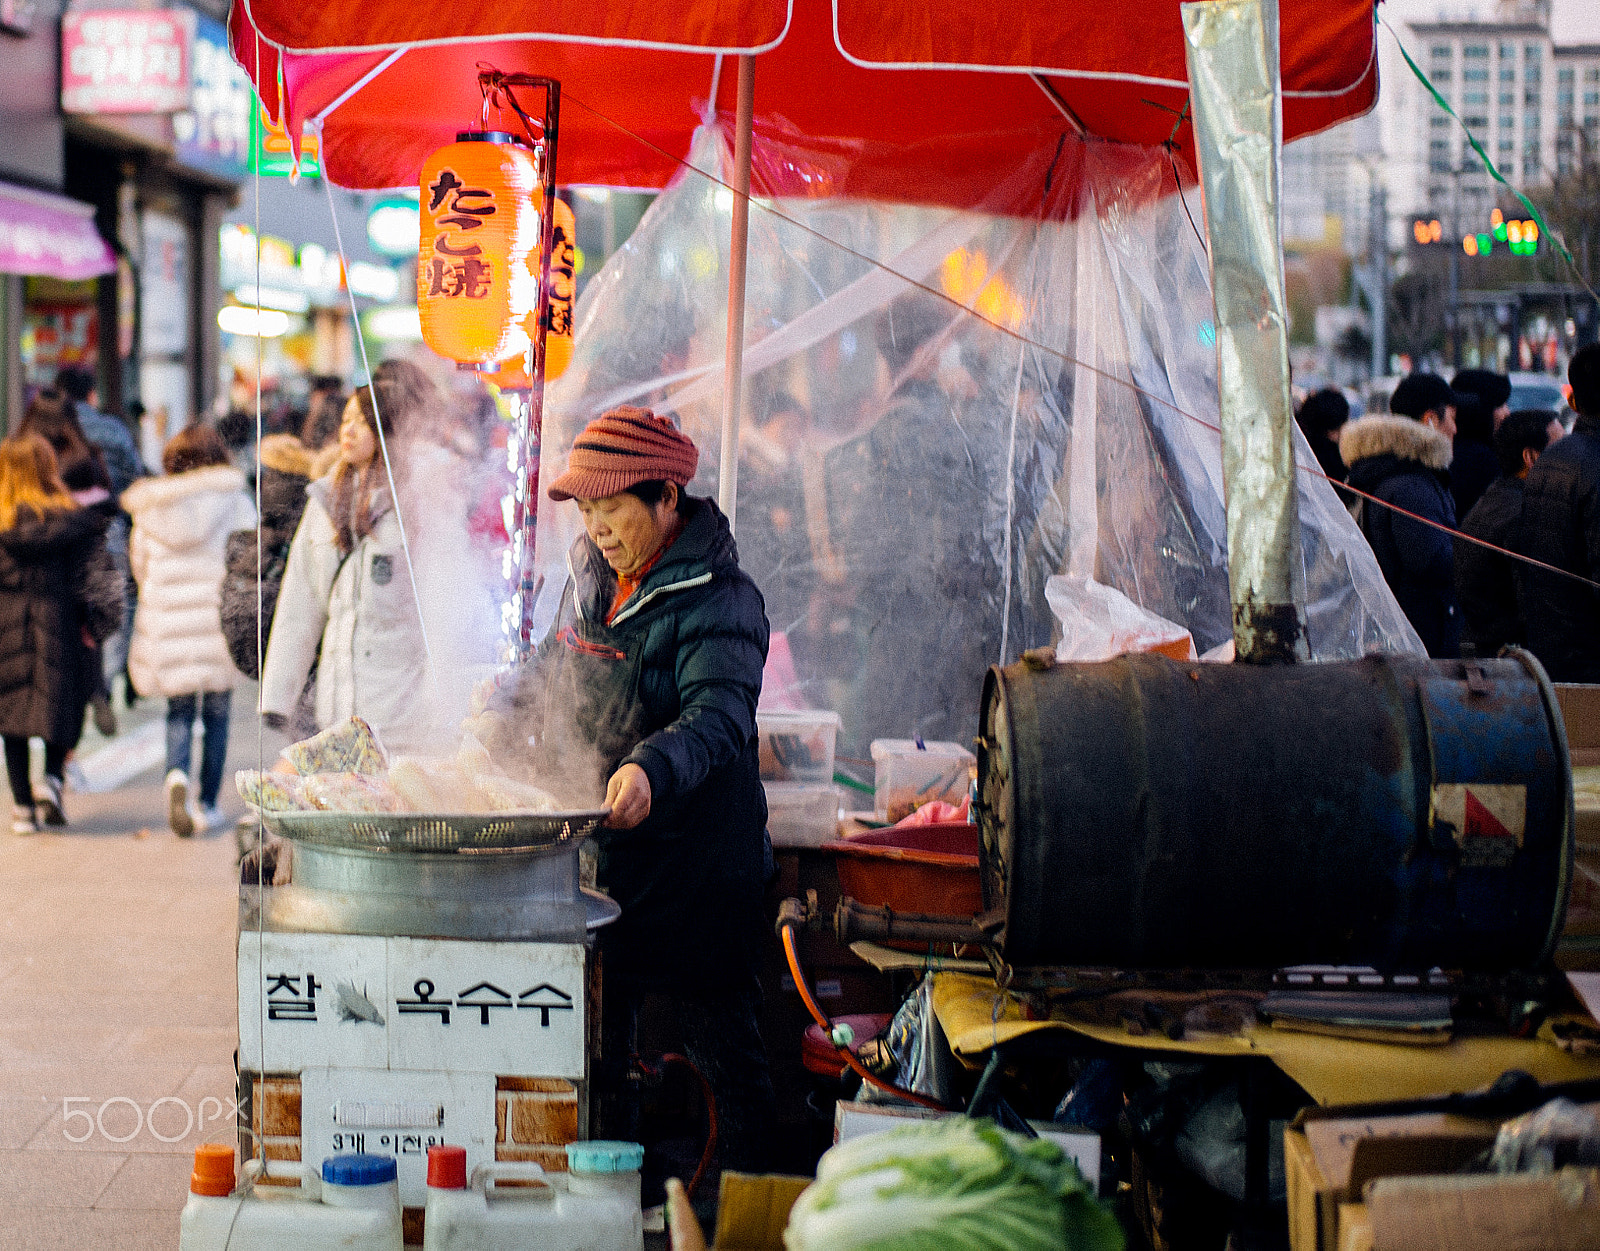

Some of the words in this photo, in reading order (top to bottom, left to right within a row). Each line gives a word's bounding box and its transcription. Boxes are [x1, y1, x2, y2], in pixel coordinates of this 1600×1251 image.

[428, 171, 497, 298] たこ焼
[267, 973, 321, 1021] 찰
[396, 979, 574, 1027] 옥수수
[333, 1132, 365, 1155] 3개
